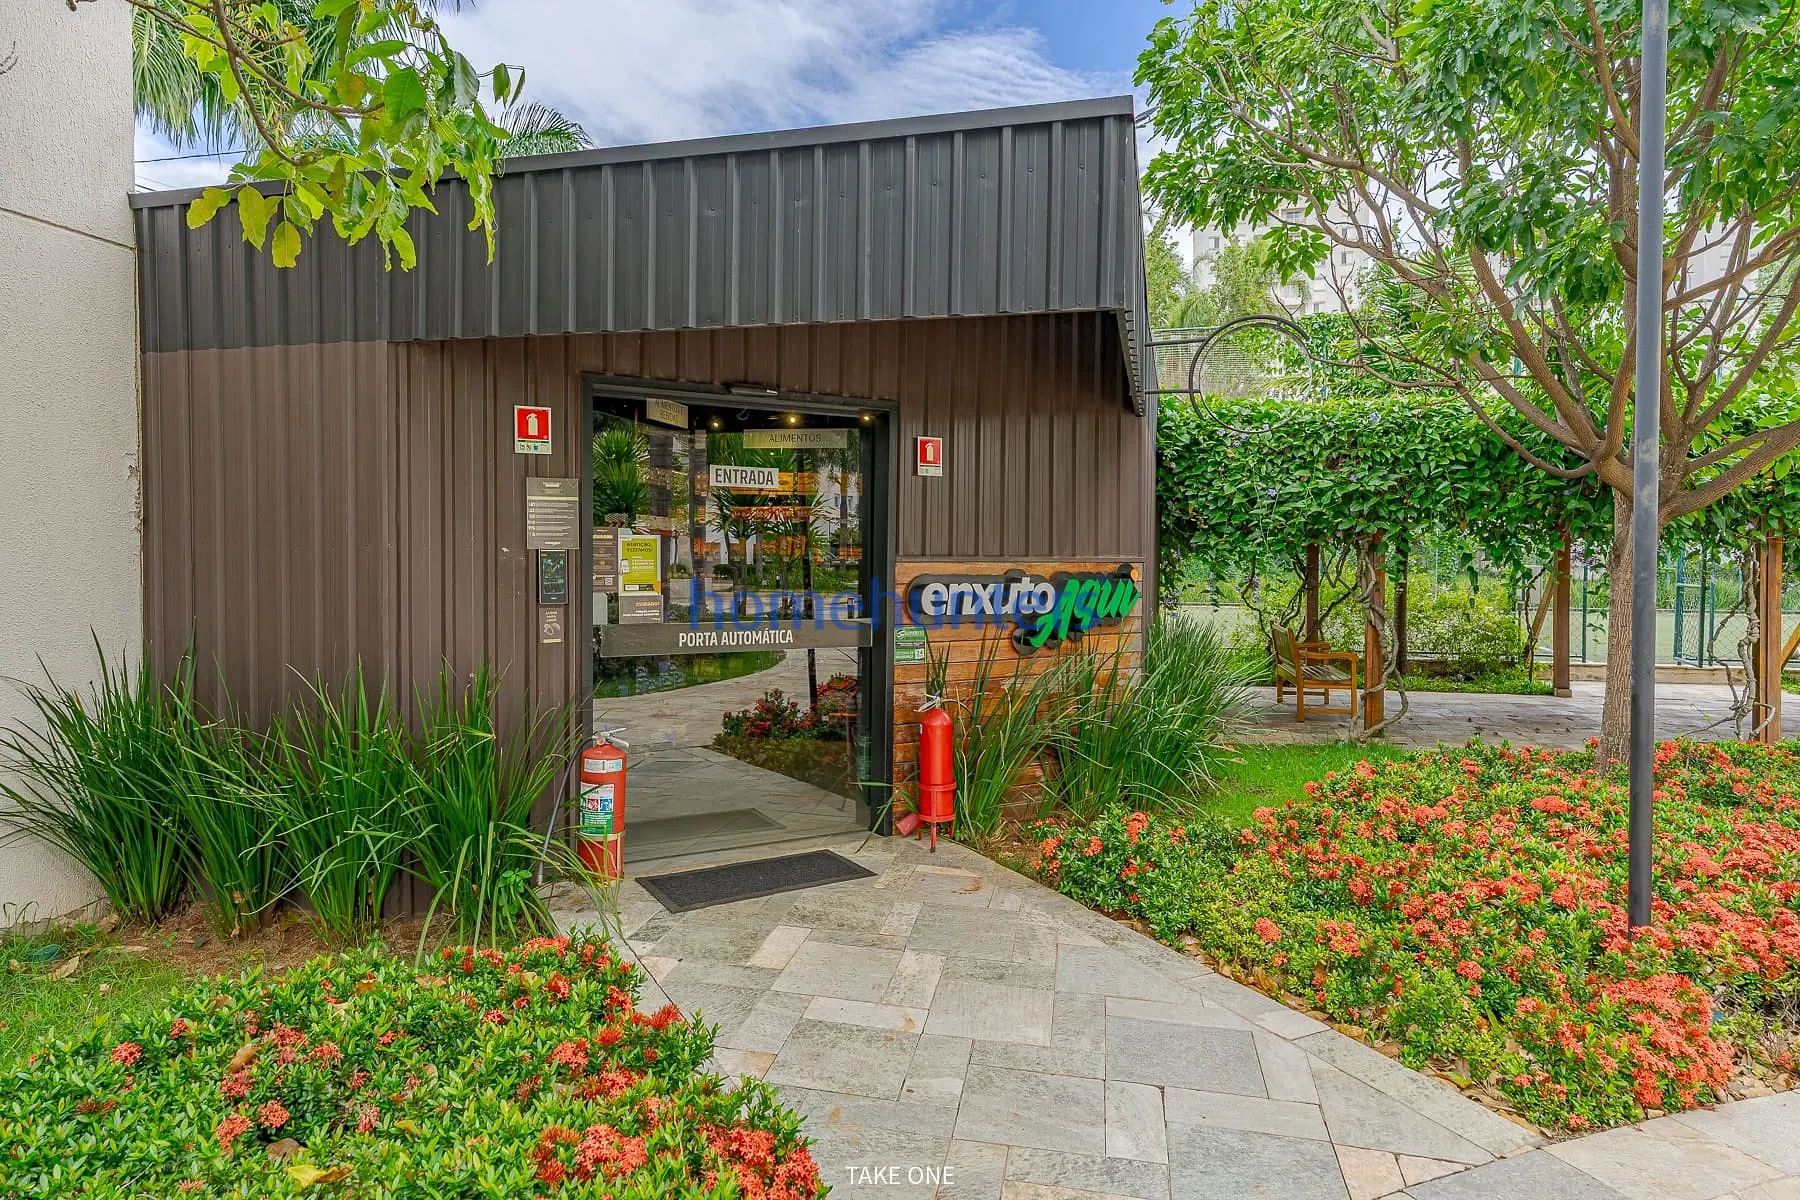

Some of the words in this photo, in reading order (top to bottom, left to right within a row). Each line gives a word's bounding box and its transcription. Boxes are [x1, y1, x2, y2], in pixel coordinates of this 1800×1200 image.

[768, 433, 822, 443] ALIMENTOS
[715, 468, 774, 486] ENTRADA
[921, 577, 1056, 616] enxuto
[678, 631, 718, 647] PORTA
[720, 627, 794, 646] AUTOMÁTICA
